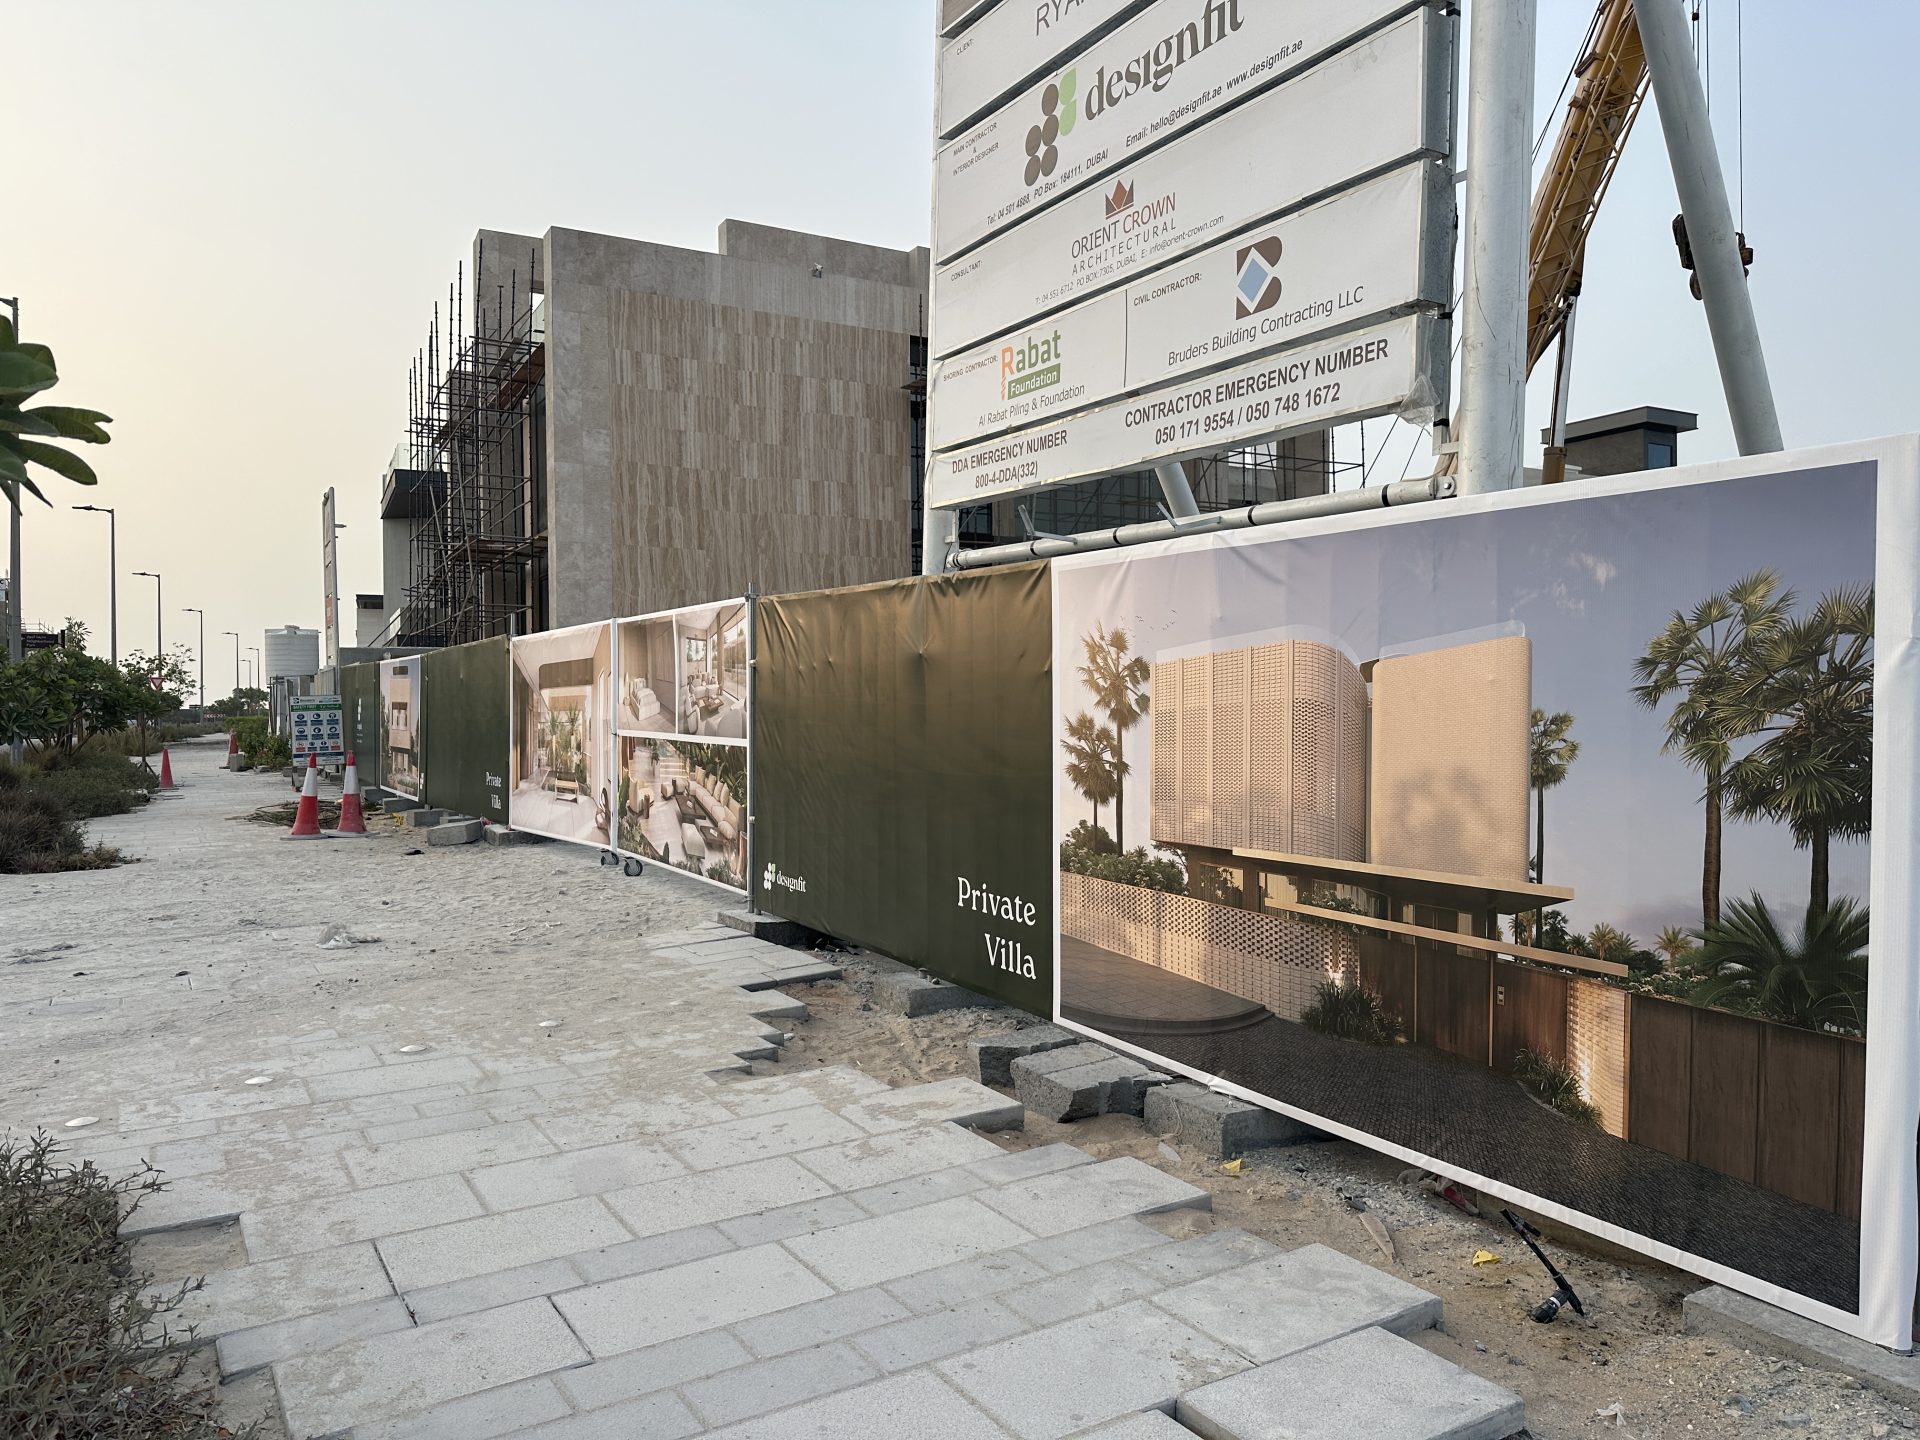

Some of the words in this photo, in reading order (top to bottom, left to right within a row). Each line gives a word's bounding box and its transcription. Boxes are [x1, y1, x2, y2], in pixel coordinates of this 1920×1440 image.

[1085, 0, 1245, 120] designfit
[965, 122, 997, 148] CONTRACTOR
[1034, 186, 1043, 199] PO
[1086, 148, 1109, 170] DUBAI
[1126, 127, 1148, 147] Email:
[1150, 86, 1222, 134] hello@designfit.ae
[1226, 39, 1303, 90] www.designfit.ae
[953, 158, 974, 176] INTERIOR
[975, 142, 999, 163] DESIGNER
[1072, 220, 1120, 258] ORIENT
[1122, 192, 1176, 234] CROWN
[1072, 218, 1177, 276] ARCHITECTURAL
[1076, 277, 1085, 287] PO
[1149, 215, 1224, 254] info@orient-crown.com
[1133, 294, 1150, 307] CIVIL
[1151, 272, 1202, 300] CONTRACTOR:
[1168, 341, 1208, 367] Bruders
[1212, 325, 1257, 351] Building
[1261, 298, 1333, 335] Contracting
[1338, 286, 1364, 309] LLC
[965, 354, 998, 374] CONTRACTOR:
[1001, 329, 1061, 378] Rabat
[978, 415, 986, 428] Al
[987, 410, 1008, 425] Rabat
[1009, 403, 1030, 419] Piling
[1031, 399, 1038, 411] &
[1040, 384, 1085, 408] Foundation
[1010, 370, 1057, 396] Foundation
[1125, 389, 1212, 428] CONTRACTOR
[1215, 361, 1310, 404] EMERGENCY
[1315, 338, 1389, 377] NUMBER
[1155, 424, 1175, 445] 050
[1179, 419, 1199, 440] 171
[1203, 409, 1234, 433] 9554
[1237, 407, 1244, 425] /
[1245, 402, 1270, 424] 050
[1274, 392, 1300, 416] 748
[1305, 382, 1341, 408] 1672
[952, 457, 969, 474] DDA
[970, 442, 1024, 469] EMERGENCY
[1026, 429, 1068, 454] NUMBER
[975, 461, 1038, 489] 800-4-DDA(332)
[776, 870, 806, 892] designfit
[957, 876, 1036, 926] Private
[984, 933, 1037, 980] Villa
